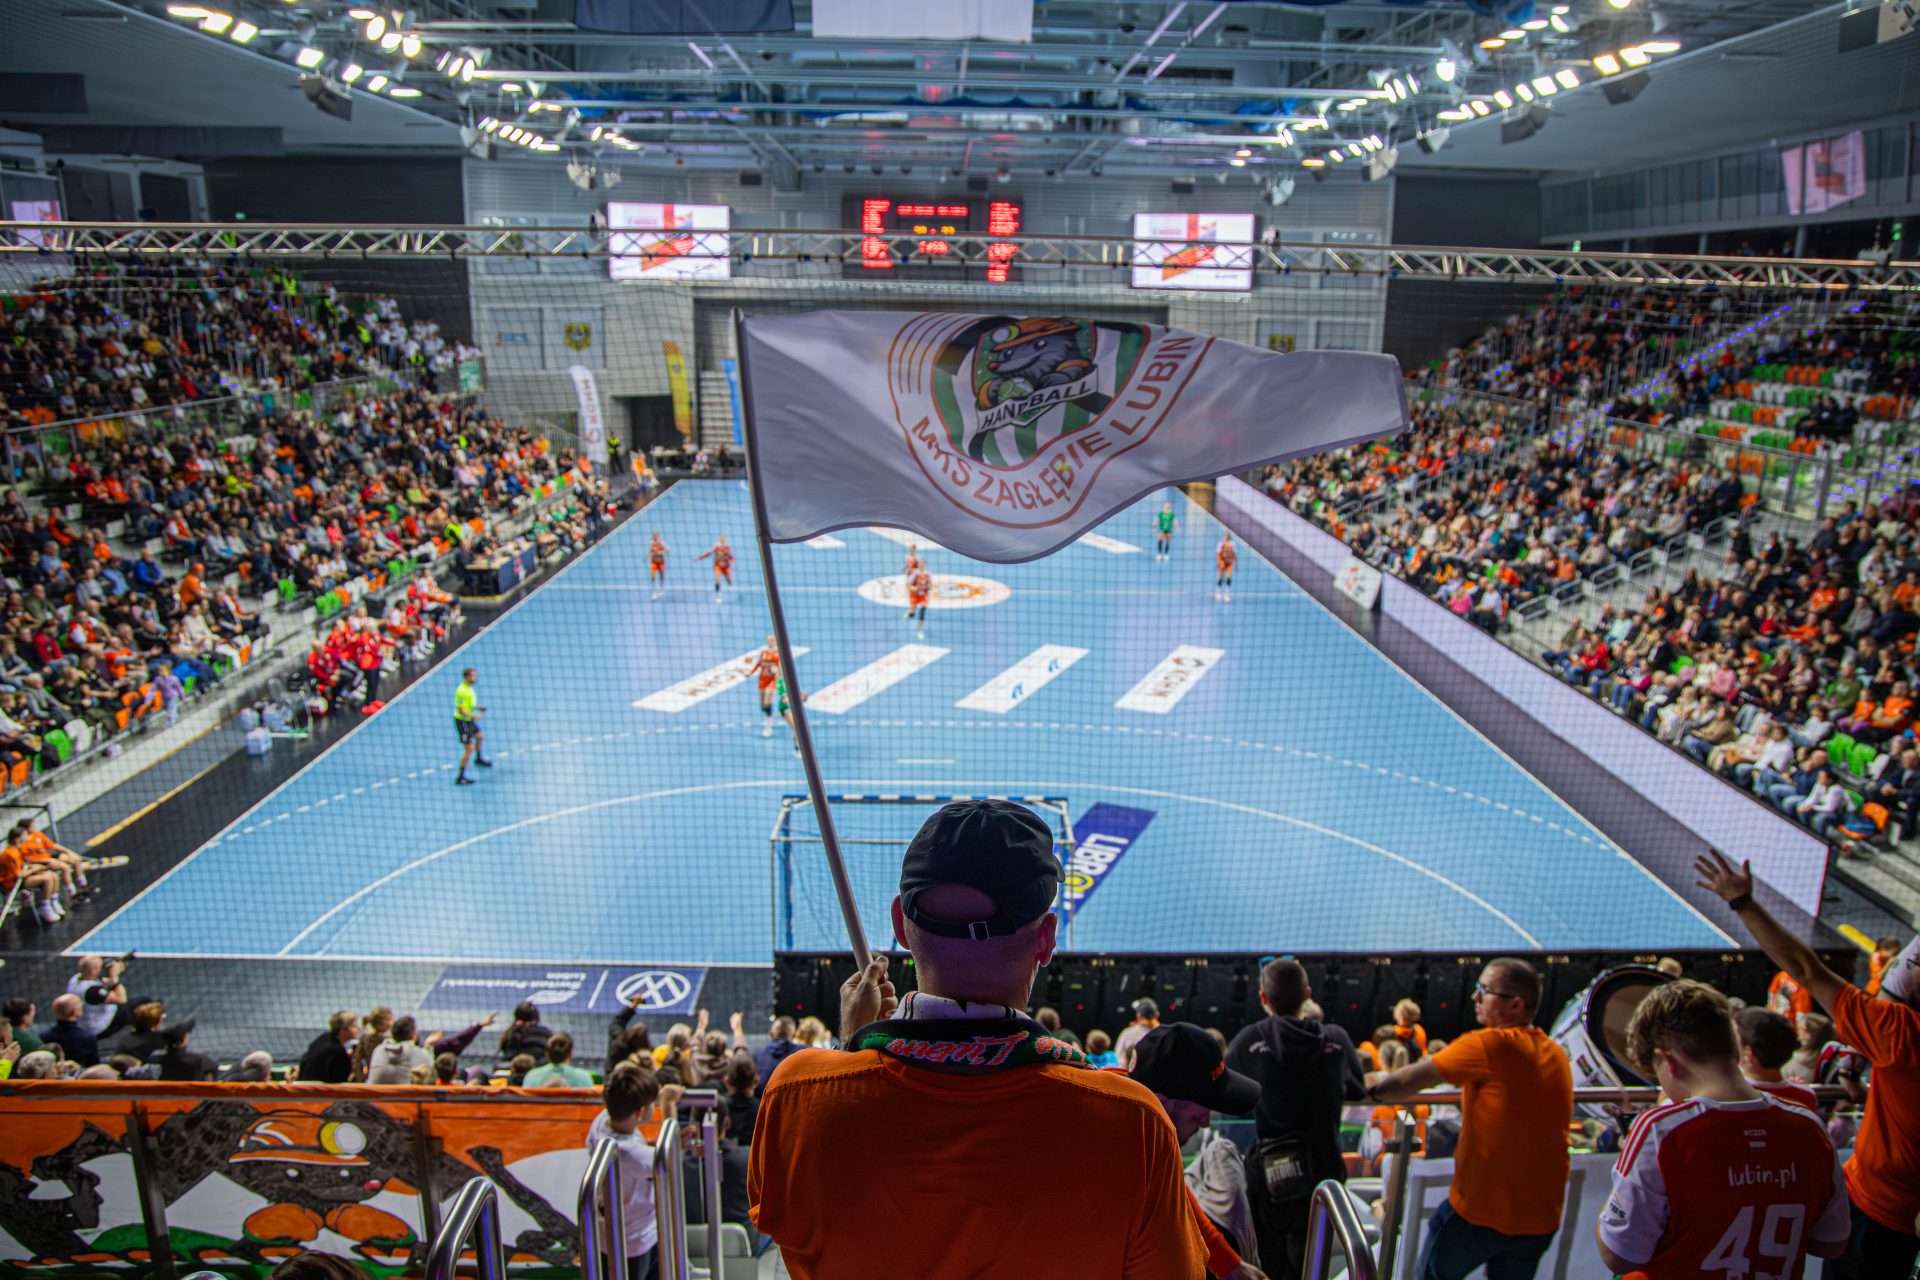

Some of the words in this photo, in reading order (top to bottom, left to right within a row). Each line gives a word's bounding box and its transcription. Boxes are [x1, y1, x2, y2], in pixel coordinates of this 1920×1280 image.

[911, 414, 973, 487] MKS
[972, 431, 1113, 511] ZAGŁĘBIE
[1109, 335, 1197, 438] LUBIN
[1728, 1161, 1797, 1190] lubin.pl
[1699, 1203, 1807, 1280] 49
